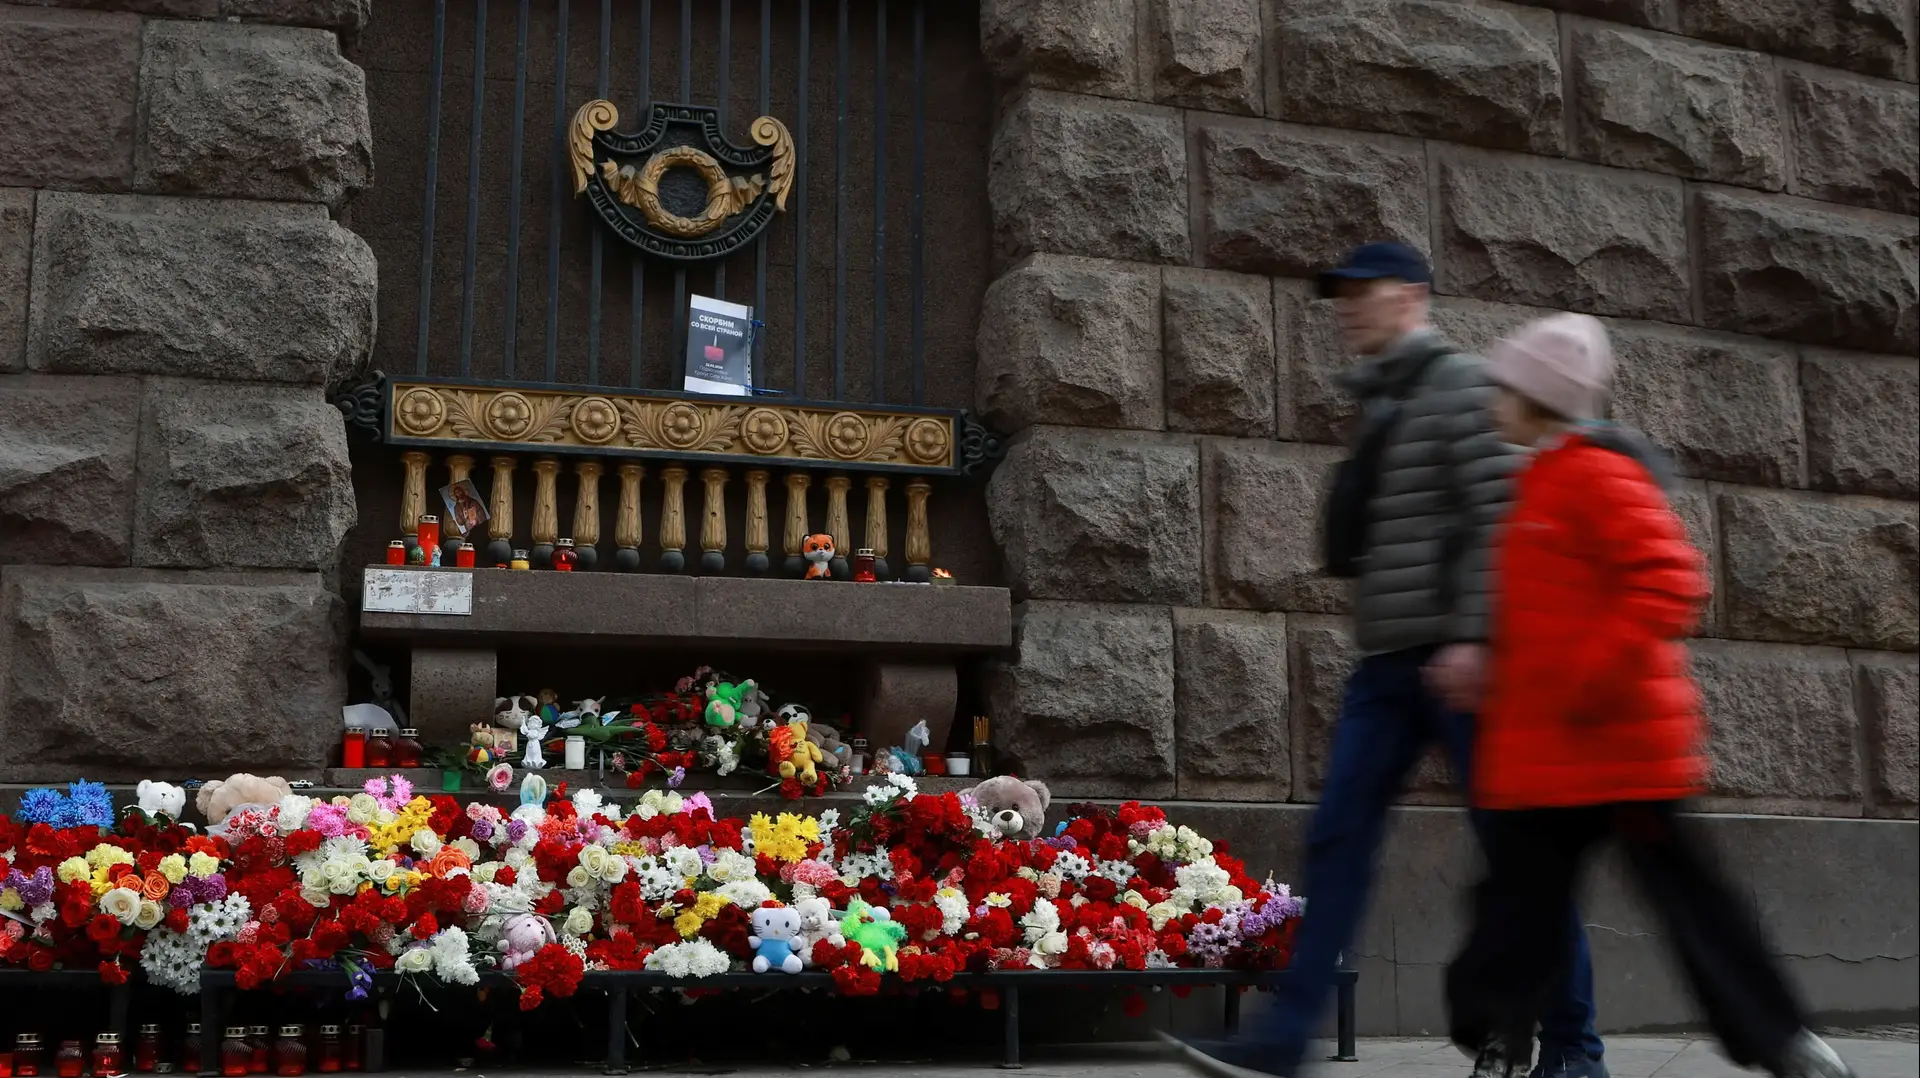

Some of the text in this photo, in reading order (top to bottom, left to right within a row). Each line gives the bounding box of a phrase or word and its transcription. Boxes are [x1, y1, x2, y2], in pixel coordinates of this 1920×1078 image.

[699, 315, 734, 328] СКОРБИМ
[700, 323, 715, 331] ВСЕЙ
[716, 327, 743, 337] СТРАНОЙ
